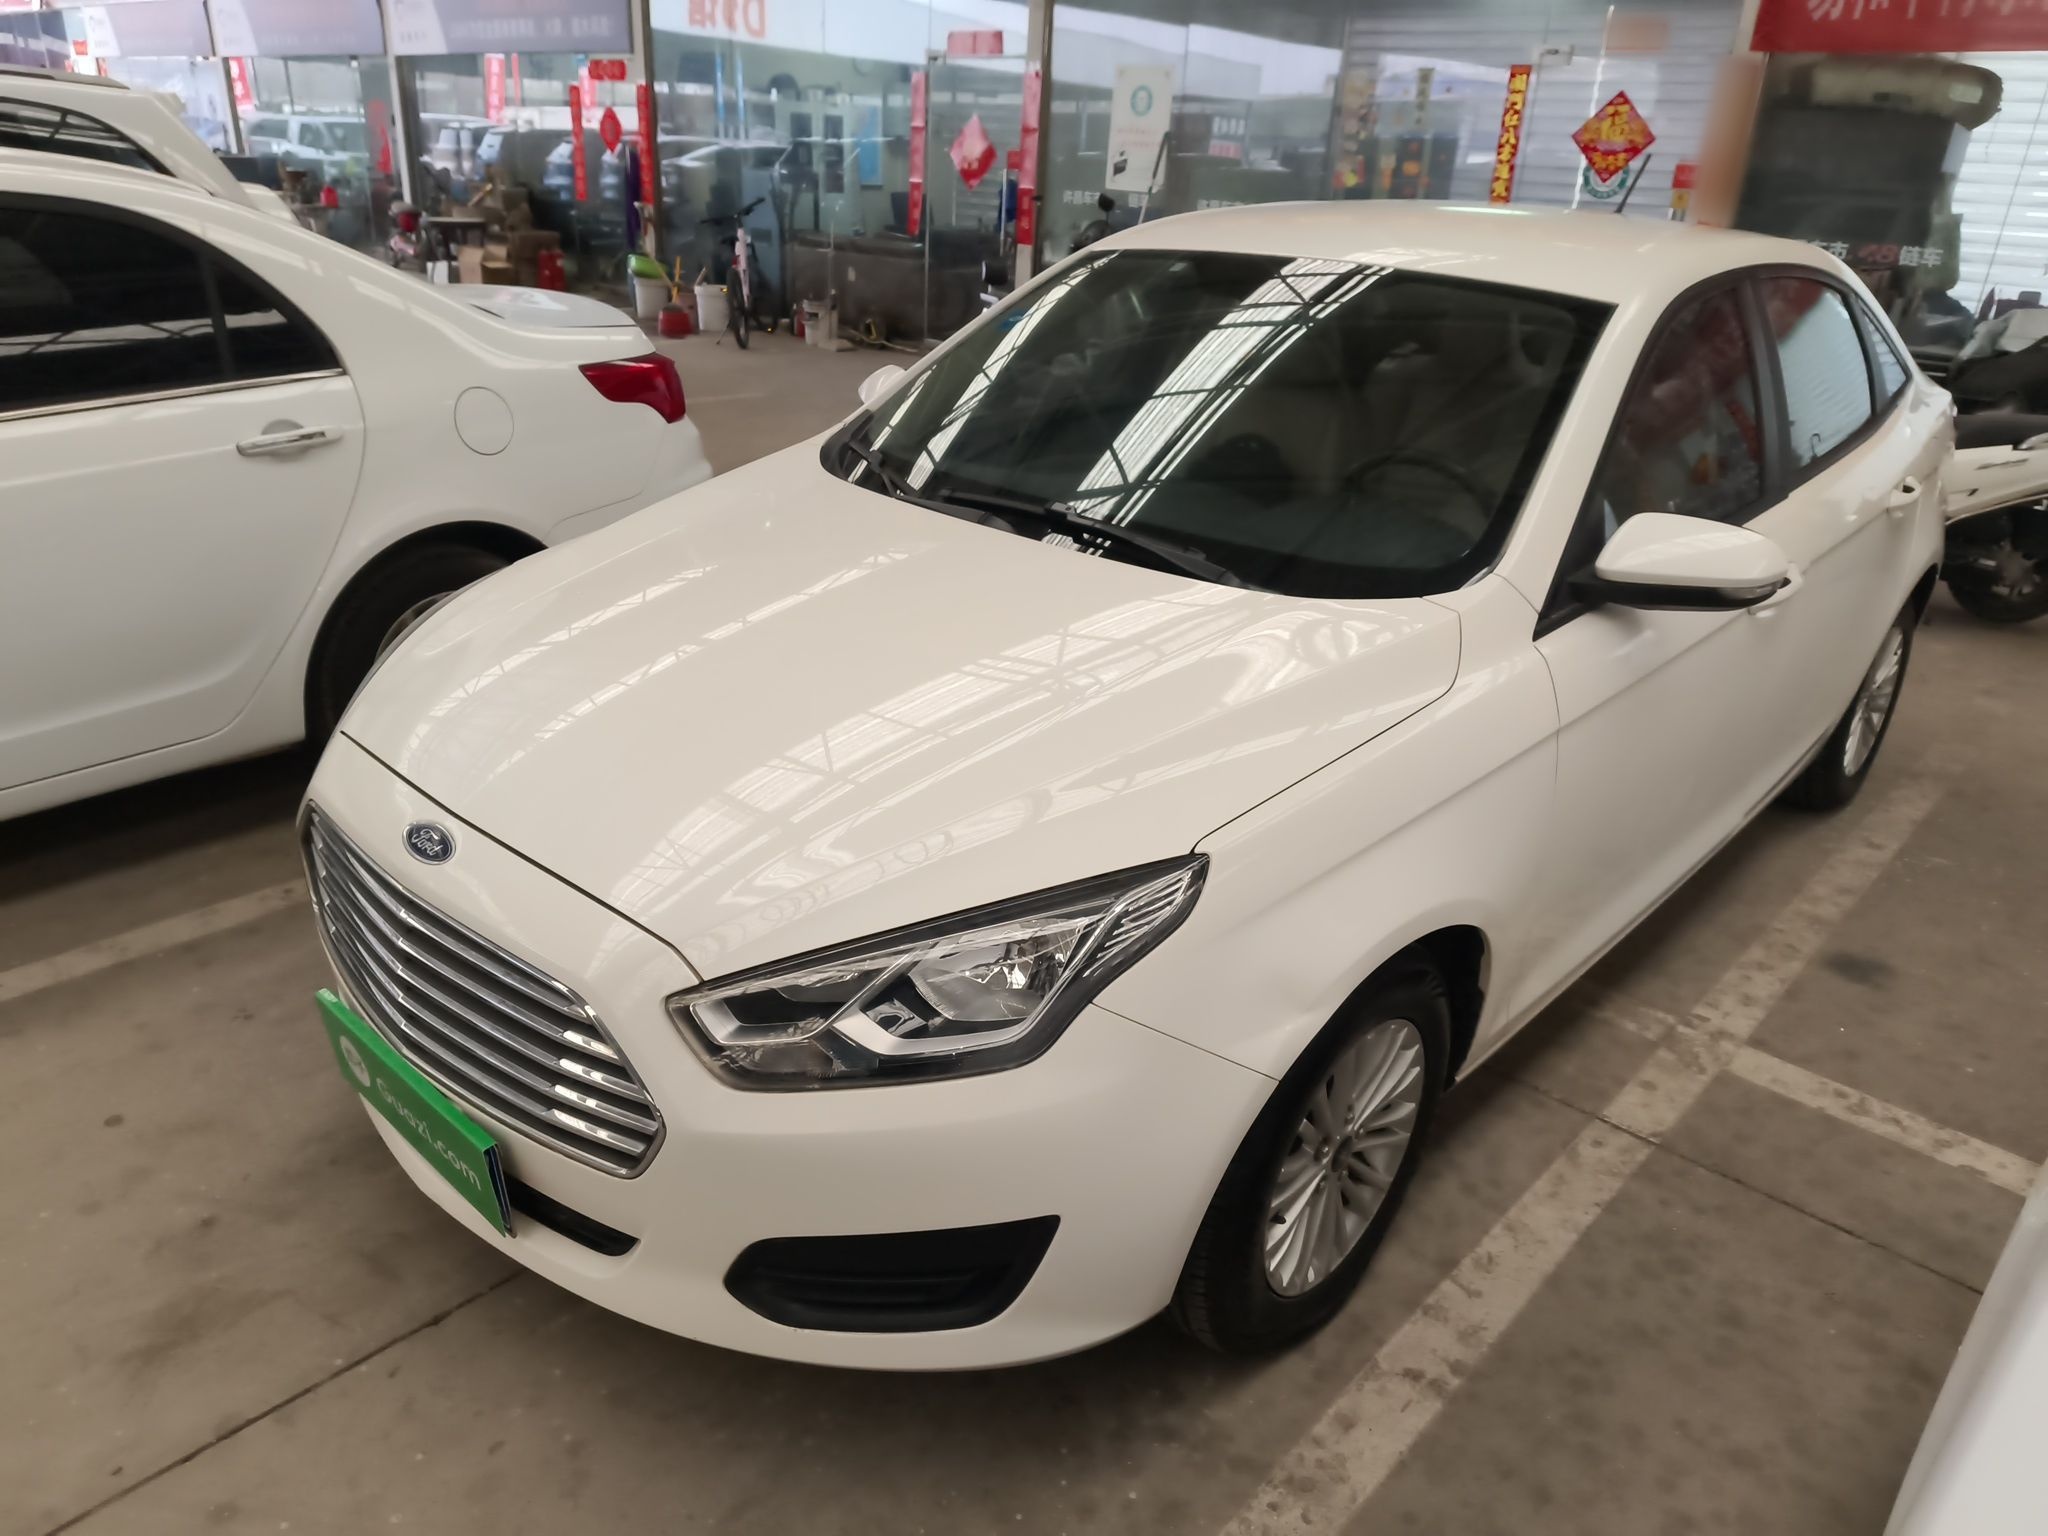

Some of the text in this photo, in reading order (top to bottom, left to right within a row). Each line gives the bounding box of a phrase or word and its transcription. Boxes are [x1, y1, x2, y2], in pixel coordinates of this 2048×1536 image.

[1600, 104, 1632, 143] 福
[411, 828, 443, 856] Ford
[376, 1077, 482, 1191] Guazi.com
